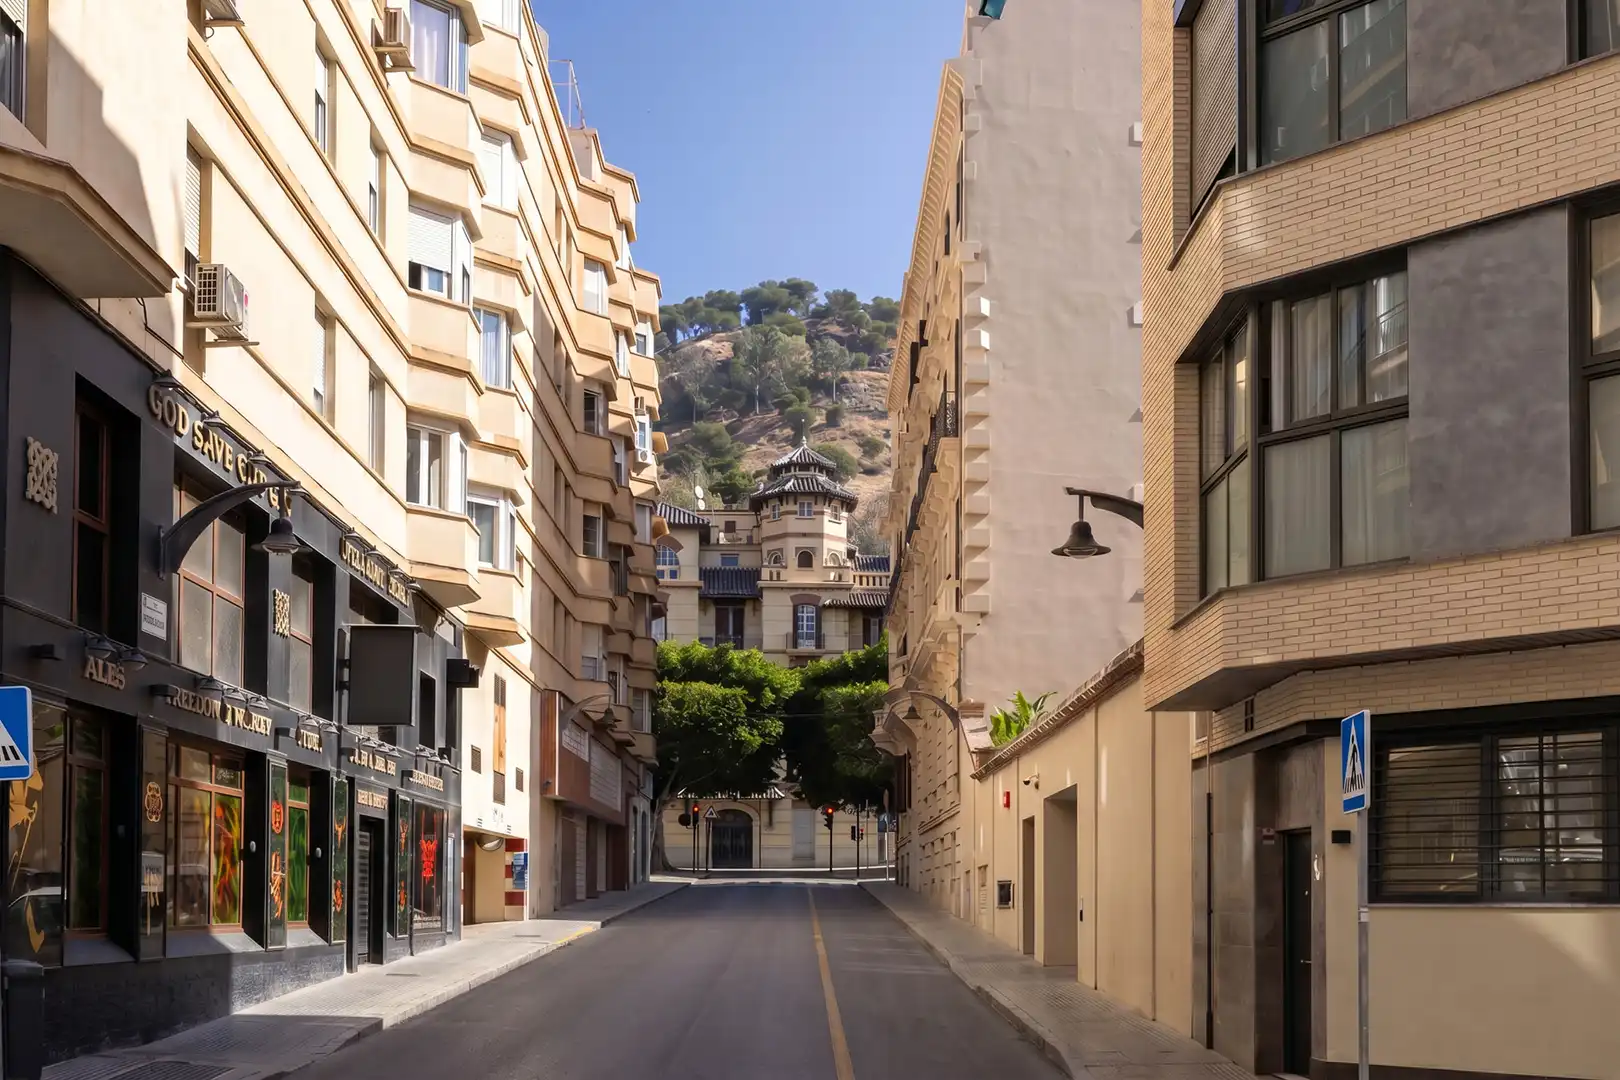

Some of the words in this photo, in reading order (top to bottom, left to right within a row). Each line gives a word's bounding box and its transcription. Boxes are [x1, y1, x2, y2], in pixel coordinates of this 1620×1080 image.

[148, 384, 190, 437] GOD
[193, 420, 234, 473] SAVE
[84, 655, 126, 690] ALES
